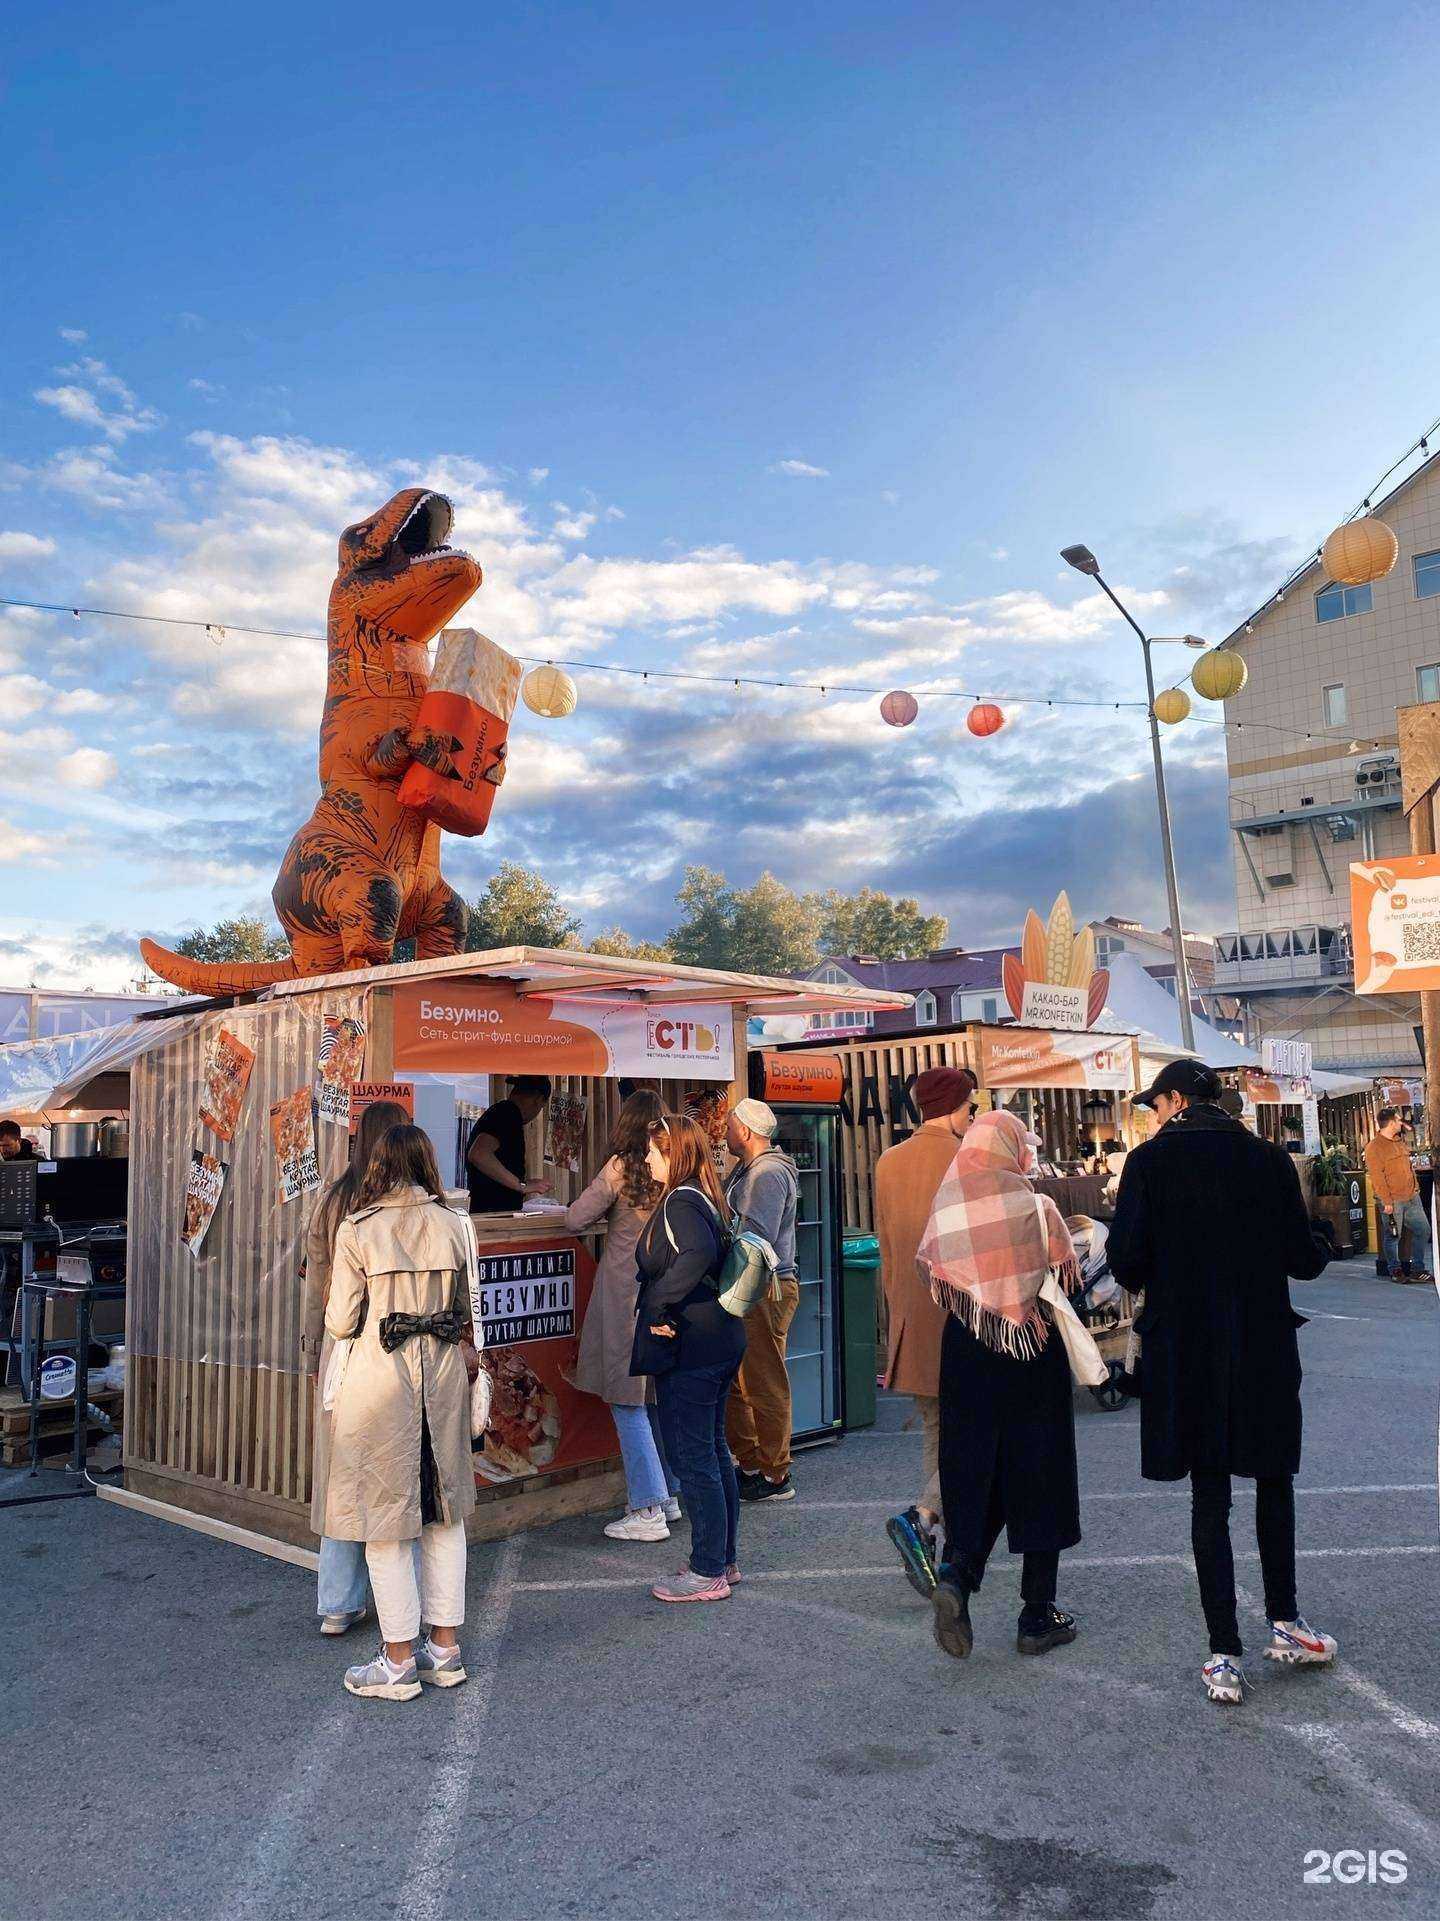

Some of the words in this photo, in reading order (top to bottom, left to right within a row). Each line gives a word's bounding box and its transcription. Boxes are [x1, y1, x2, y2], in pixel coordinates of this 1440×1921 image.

[1032, 991, 1080, 1006] КАКАО-БАР
[420, 1000, 503, 1026] Безумно.
[1025, 1006, 1083, 1023] MR.KONFETKIN
[419, 1026, 448, 1040] Сеть
[451, 1030, 512, 1044] стрит-фуд
[523, 1034, 573, 1046] шаурмой
[770, 1060, 838, 1081] Безумно.
[352, 1085, 411, 1098] ШАУРМА
[480, 1254, 571, 1280] ВНИМАНИЕ!
[480, 1281, 570, 1317] БЕЗУМНО
[527, 1314, 571, 1336] ШАУРМА
